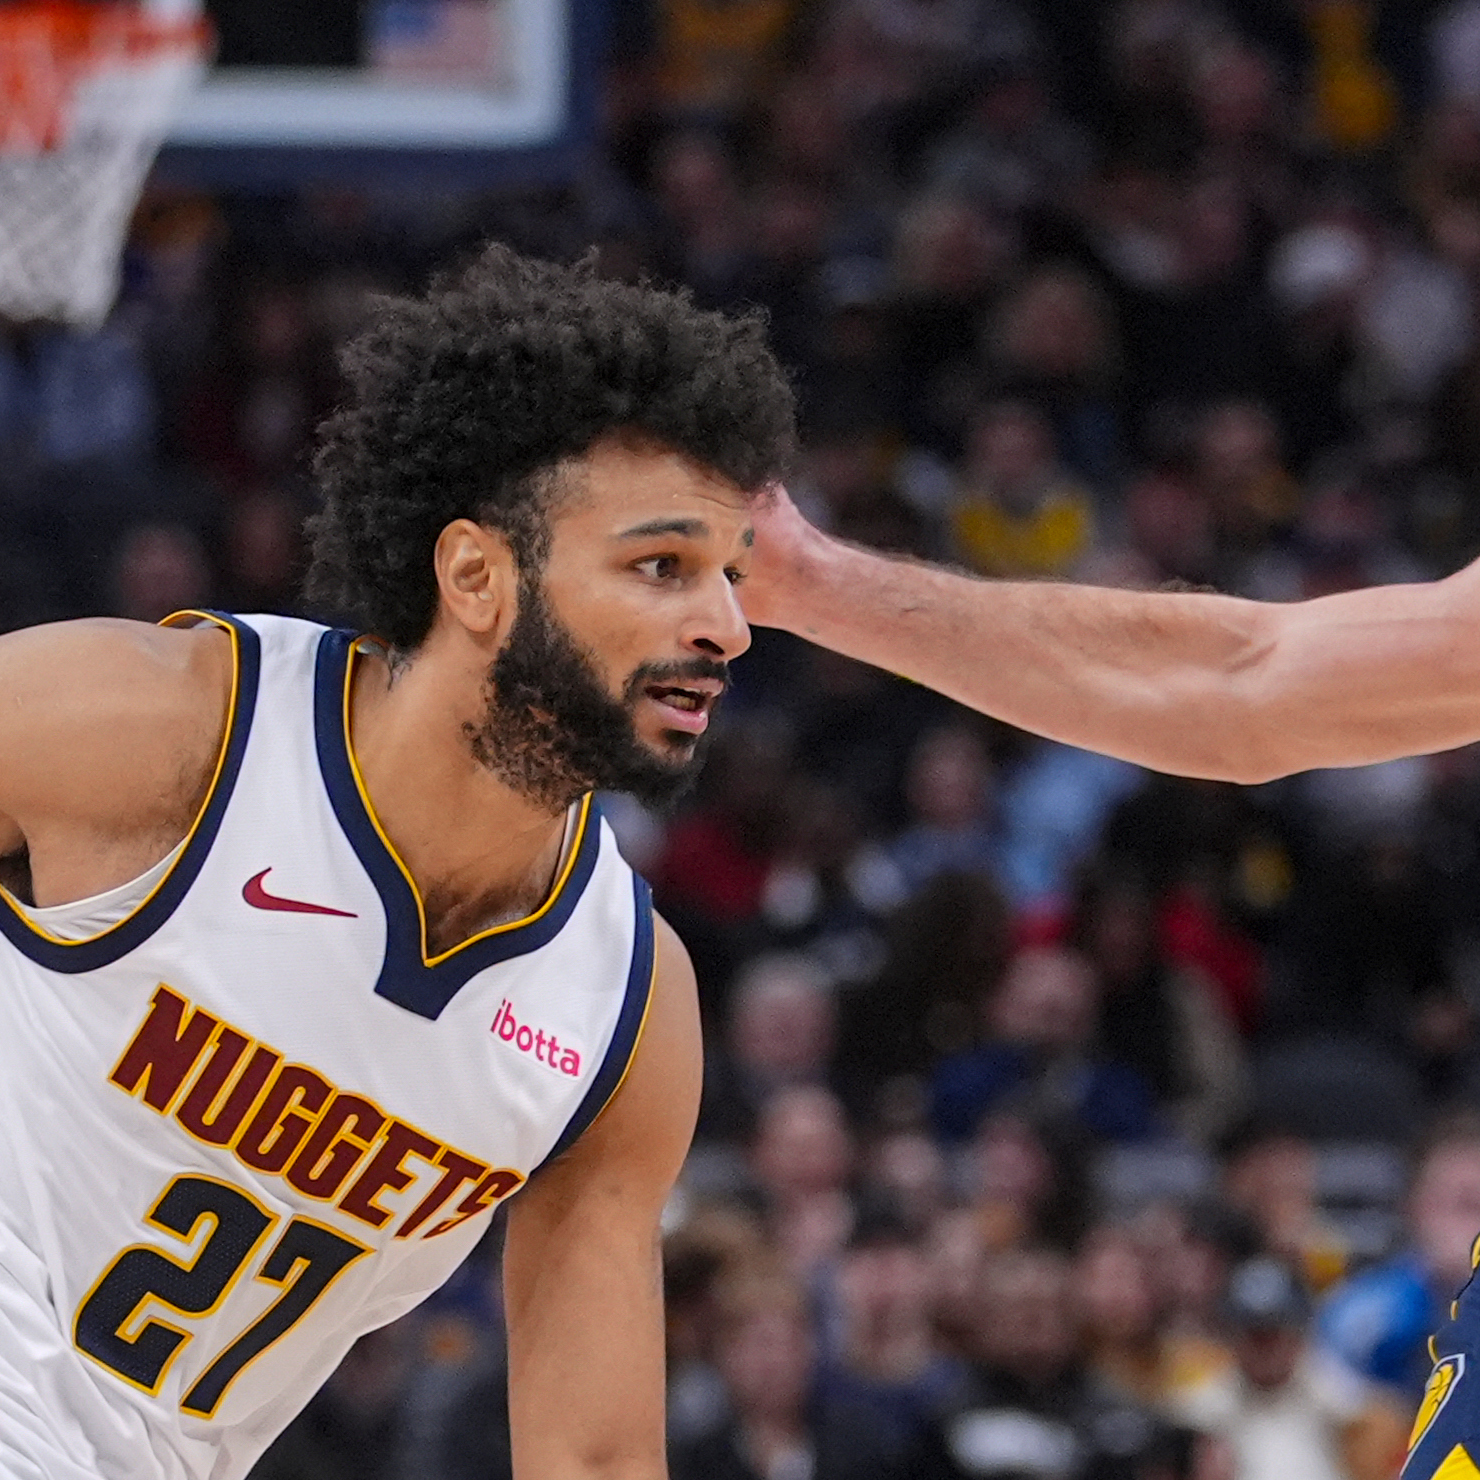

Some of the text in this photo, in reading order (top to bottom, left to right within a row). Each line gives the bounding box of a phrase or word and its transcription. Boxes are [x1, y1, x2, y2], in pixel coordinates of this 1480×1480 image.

[106, 982, 528, 1240] NUGGETS
[490, 998, 580, 1076] ibotta
[72, 1172, 378, 1420] 27
